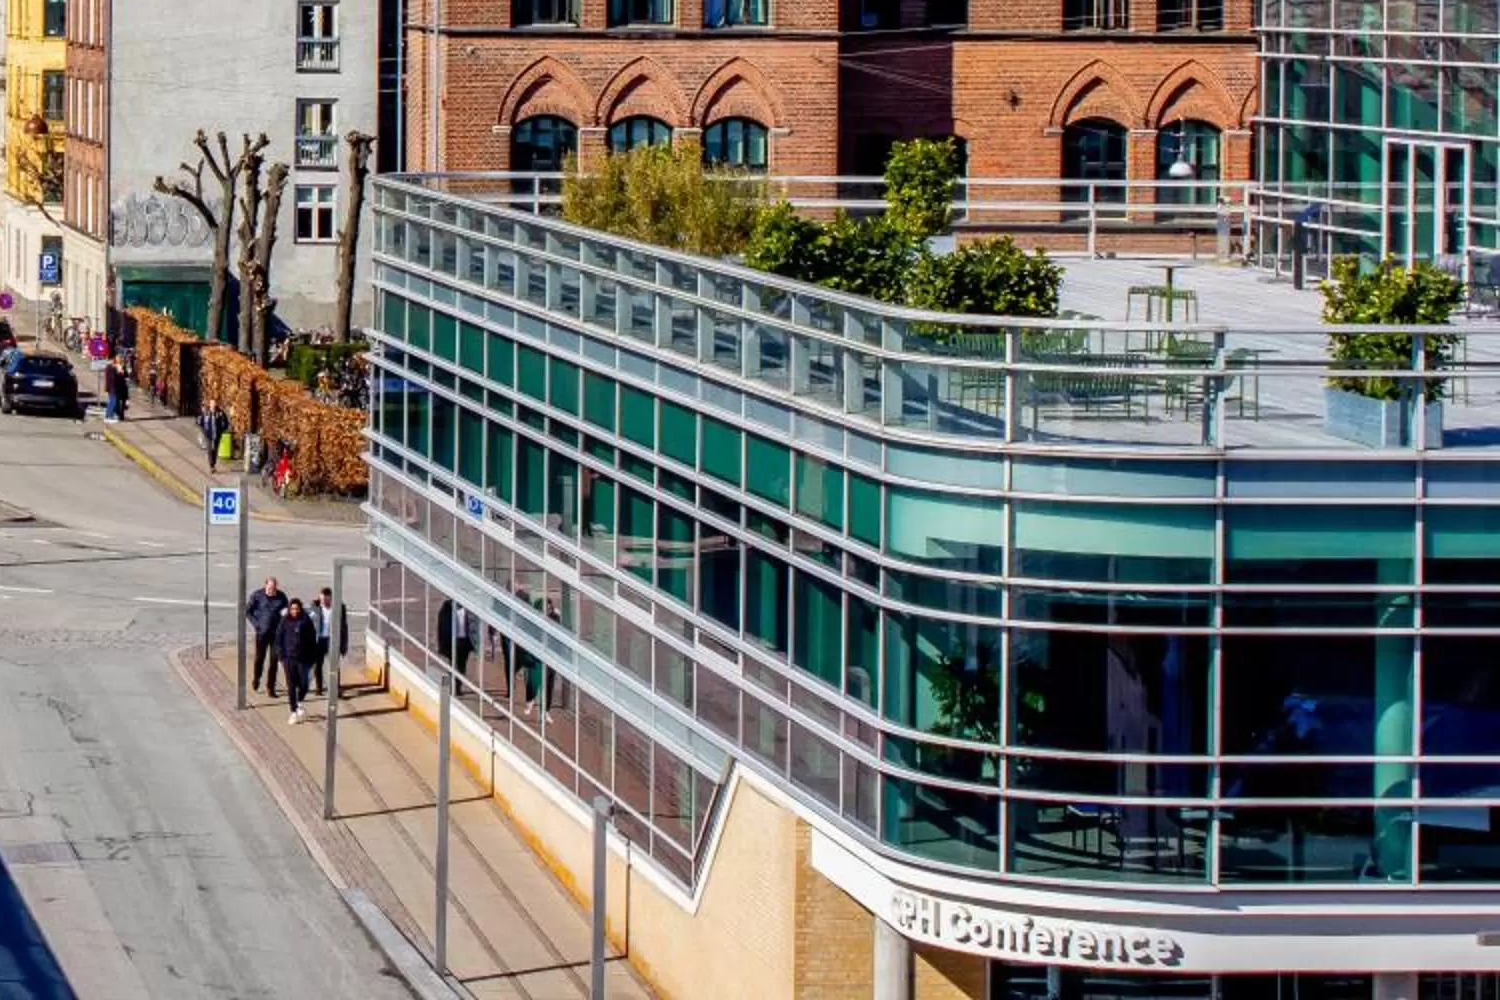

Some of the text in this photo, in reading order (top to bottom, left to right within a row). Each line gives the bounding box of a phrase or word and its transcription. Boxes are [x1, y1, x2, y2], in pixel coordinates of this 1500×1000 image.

[43, 255, 53, 269] P
[212, 496, 235, 510] 40
[947, 904, 1184, 966] Conference
